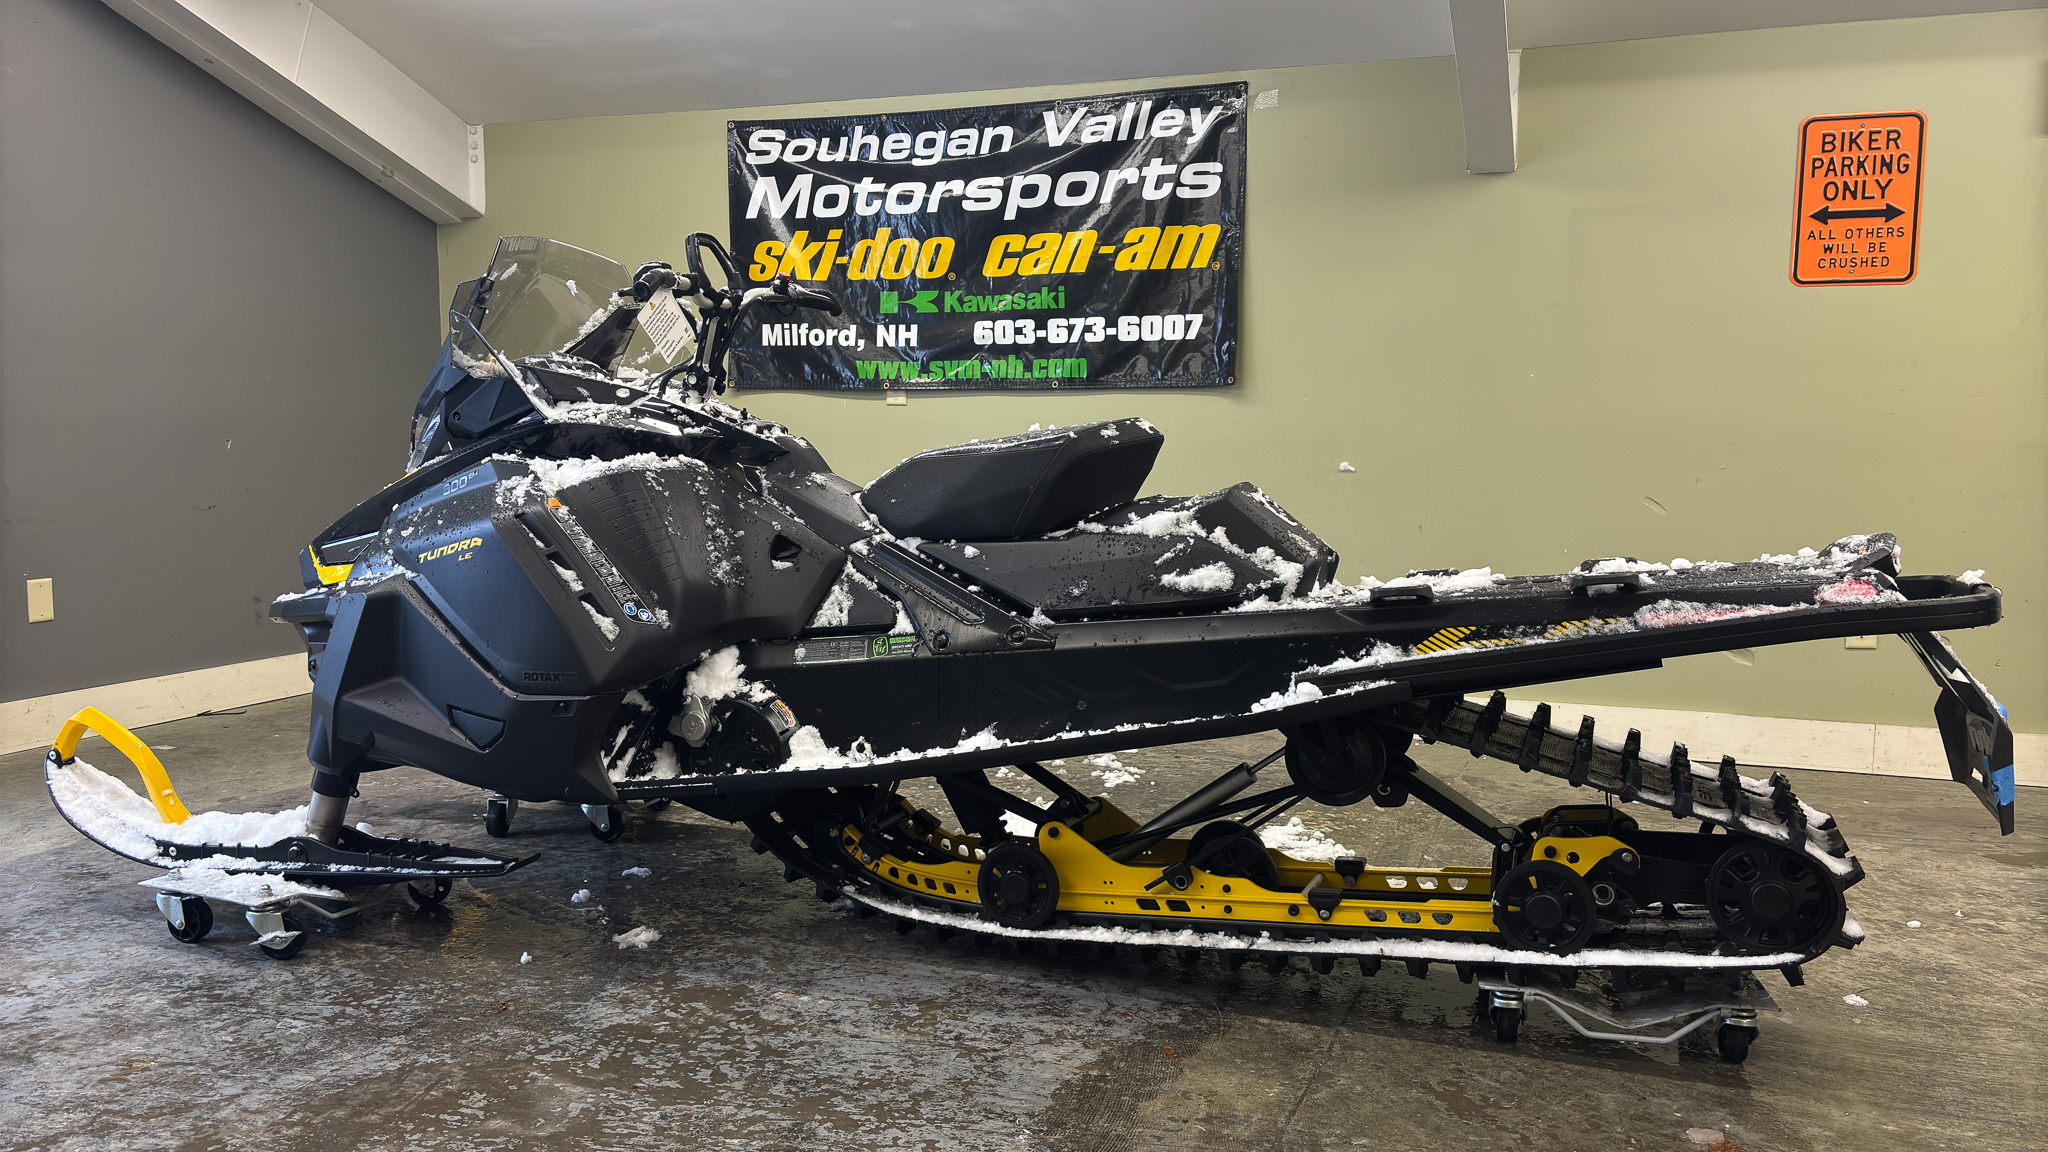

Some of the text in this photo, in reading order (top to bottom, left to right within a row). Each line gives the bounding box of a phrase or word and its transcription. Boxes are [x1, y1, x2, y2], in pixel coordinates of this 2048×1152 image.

[745, 100, 1224, 167] Souhegan Valley
[1821, 129, 1902, 153] BIKER
[1811, 153, 1911, 178] PARKING
[745, 157, 1224, 221] Motorsports
[1823, 178, 1894, 201] ONLY
[1807, 226, 1905, 241] ALL OTHERS
[982, 224, 1222, 277] can-am
[1823, 241, 1887, 254] WILL BE
[1818, 256, 1890, 269] CRUSHED
[944, 286, 1066, 313] Kawasaki
[761, 323, 918, 351] Milford, NH
[973, 314, 1203, 345] 603-673-6007
[856, 354, 1087, 380] www.svm-nh.com
[418, 537, 483, 564] TUNDRA
[458, 551, 473, 561] LE
[523, 672, 561, 682] ROTAX
